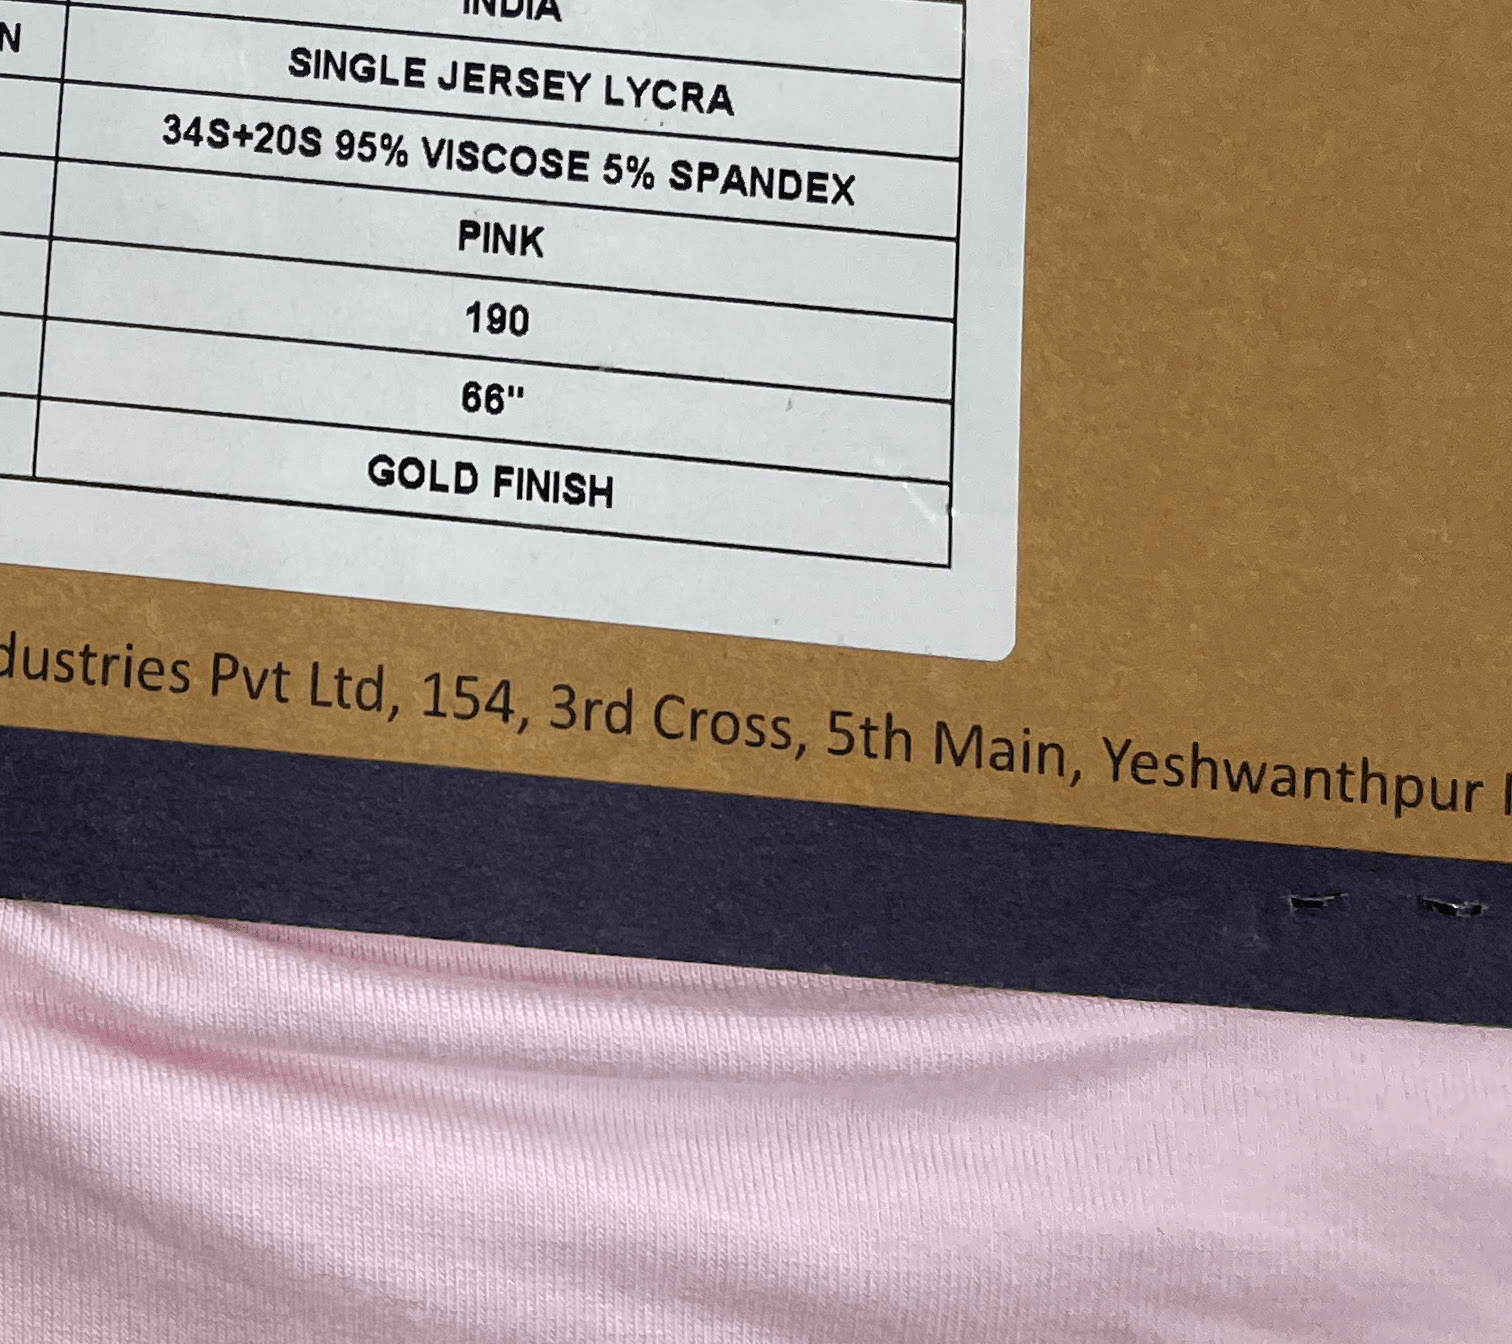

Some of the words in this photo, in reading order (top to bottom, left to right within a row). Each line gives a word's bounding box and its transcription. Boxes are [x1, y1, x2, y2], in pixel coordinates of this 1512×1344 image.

[289, 47, 426, 88] SINGLE
[438, 61, 591, 102] JERSEY
[605, 75, 734, 116] LYCRA
[163, 114, 321, 157] 34S+20S
[336, 130, 408, 167] 95%
[422, 137, 589, 182] VISCOSE
[604, 153, 654, 189] 5%
[669, 160, 855, 206] SPANDEX
[459, 220, 544, 258] PINK
[466, 301, 529, 337] 190
[368, 454, 478, 495] GOLD
[494, 465, 613, 508] FINISH
[212, 652, 290, 703] Pvt
[311, 662, 398, 722] Ltd,
[424, 673, 528, 734] 154,
[550, 684, 632, 735] 3rd
[654, 694, 805, 761] Cross,
[828, 711, 911, 762] 5th
[935, 721, 1080, 787] Main,
[1103, 737, 1484, 818] Yeshwanthpur
